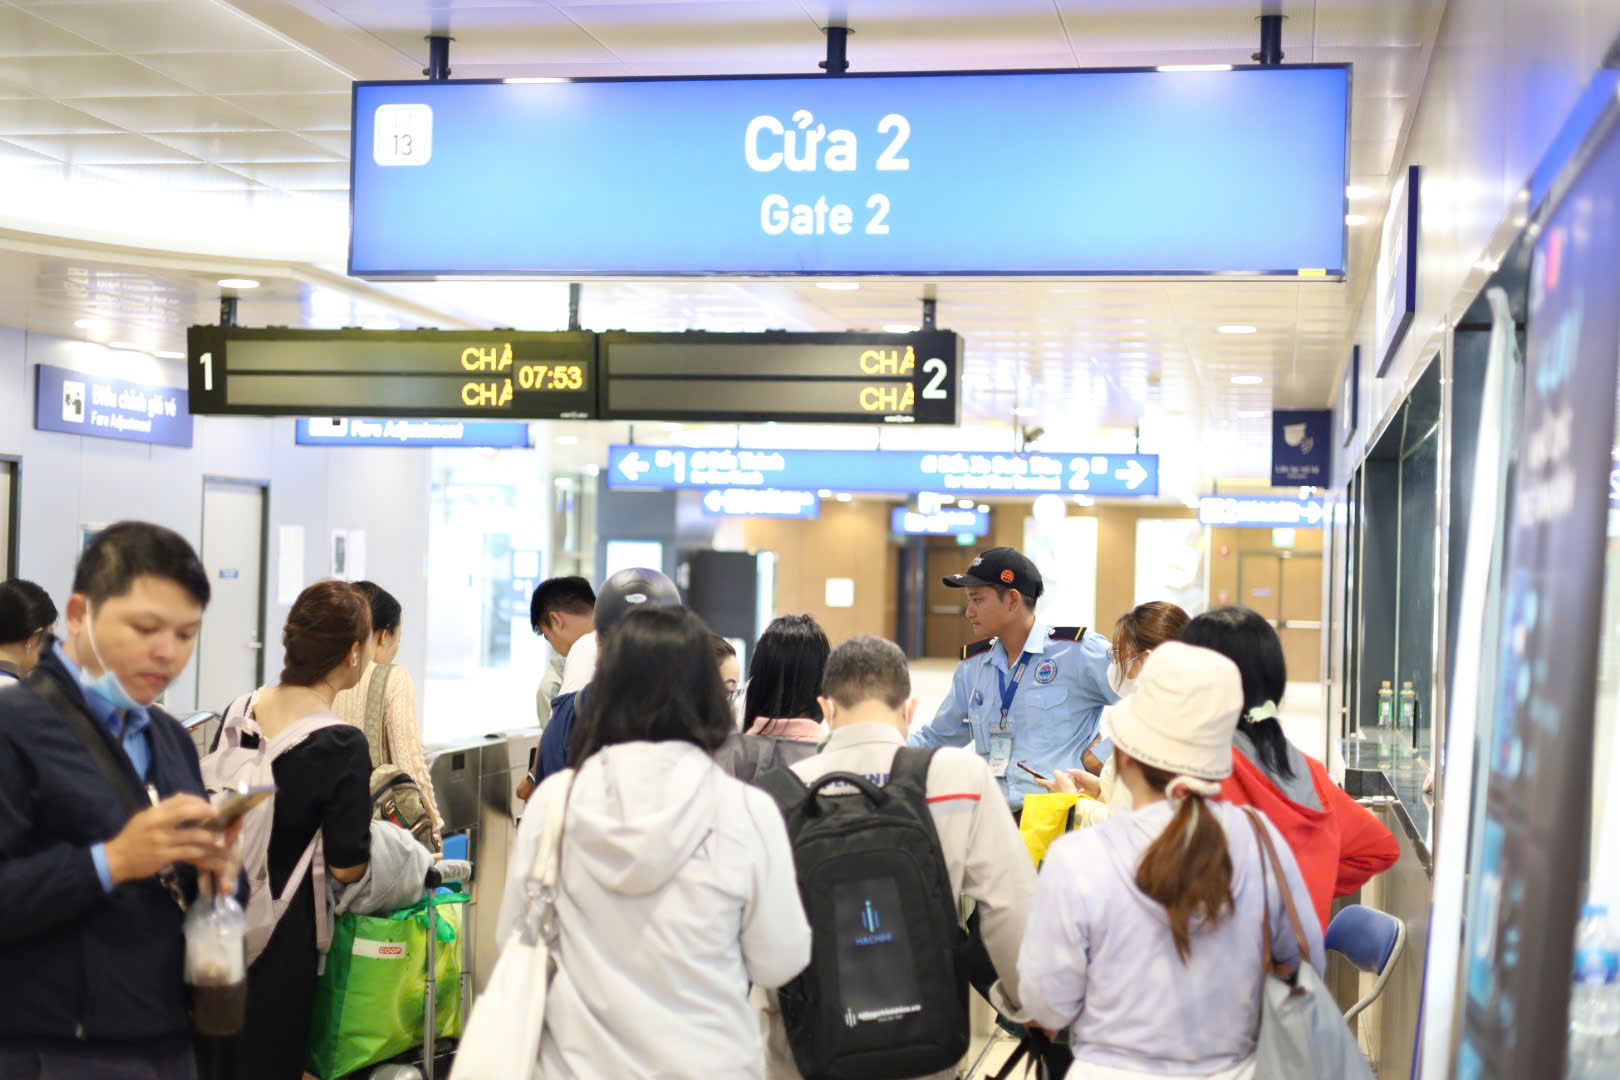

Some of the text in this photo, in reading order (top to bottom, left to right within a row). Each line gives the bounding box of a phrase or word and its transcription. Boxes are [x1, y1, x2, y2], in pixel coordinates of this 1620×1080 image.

[393, 133, 413, 156] 13
[745, 109, 911, 172] Cửa 2
[760, 193, 891, 235] Gate 2
[200, 351, 213, 391] 1
[518, 365, 583, 389] 07:53
[922, 357, 948, 400] 2
